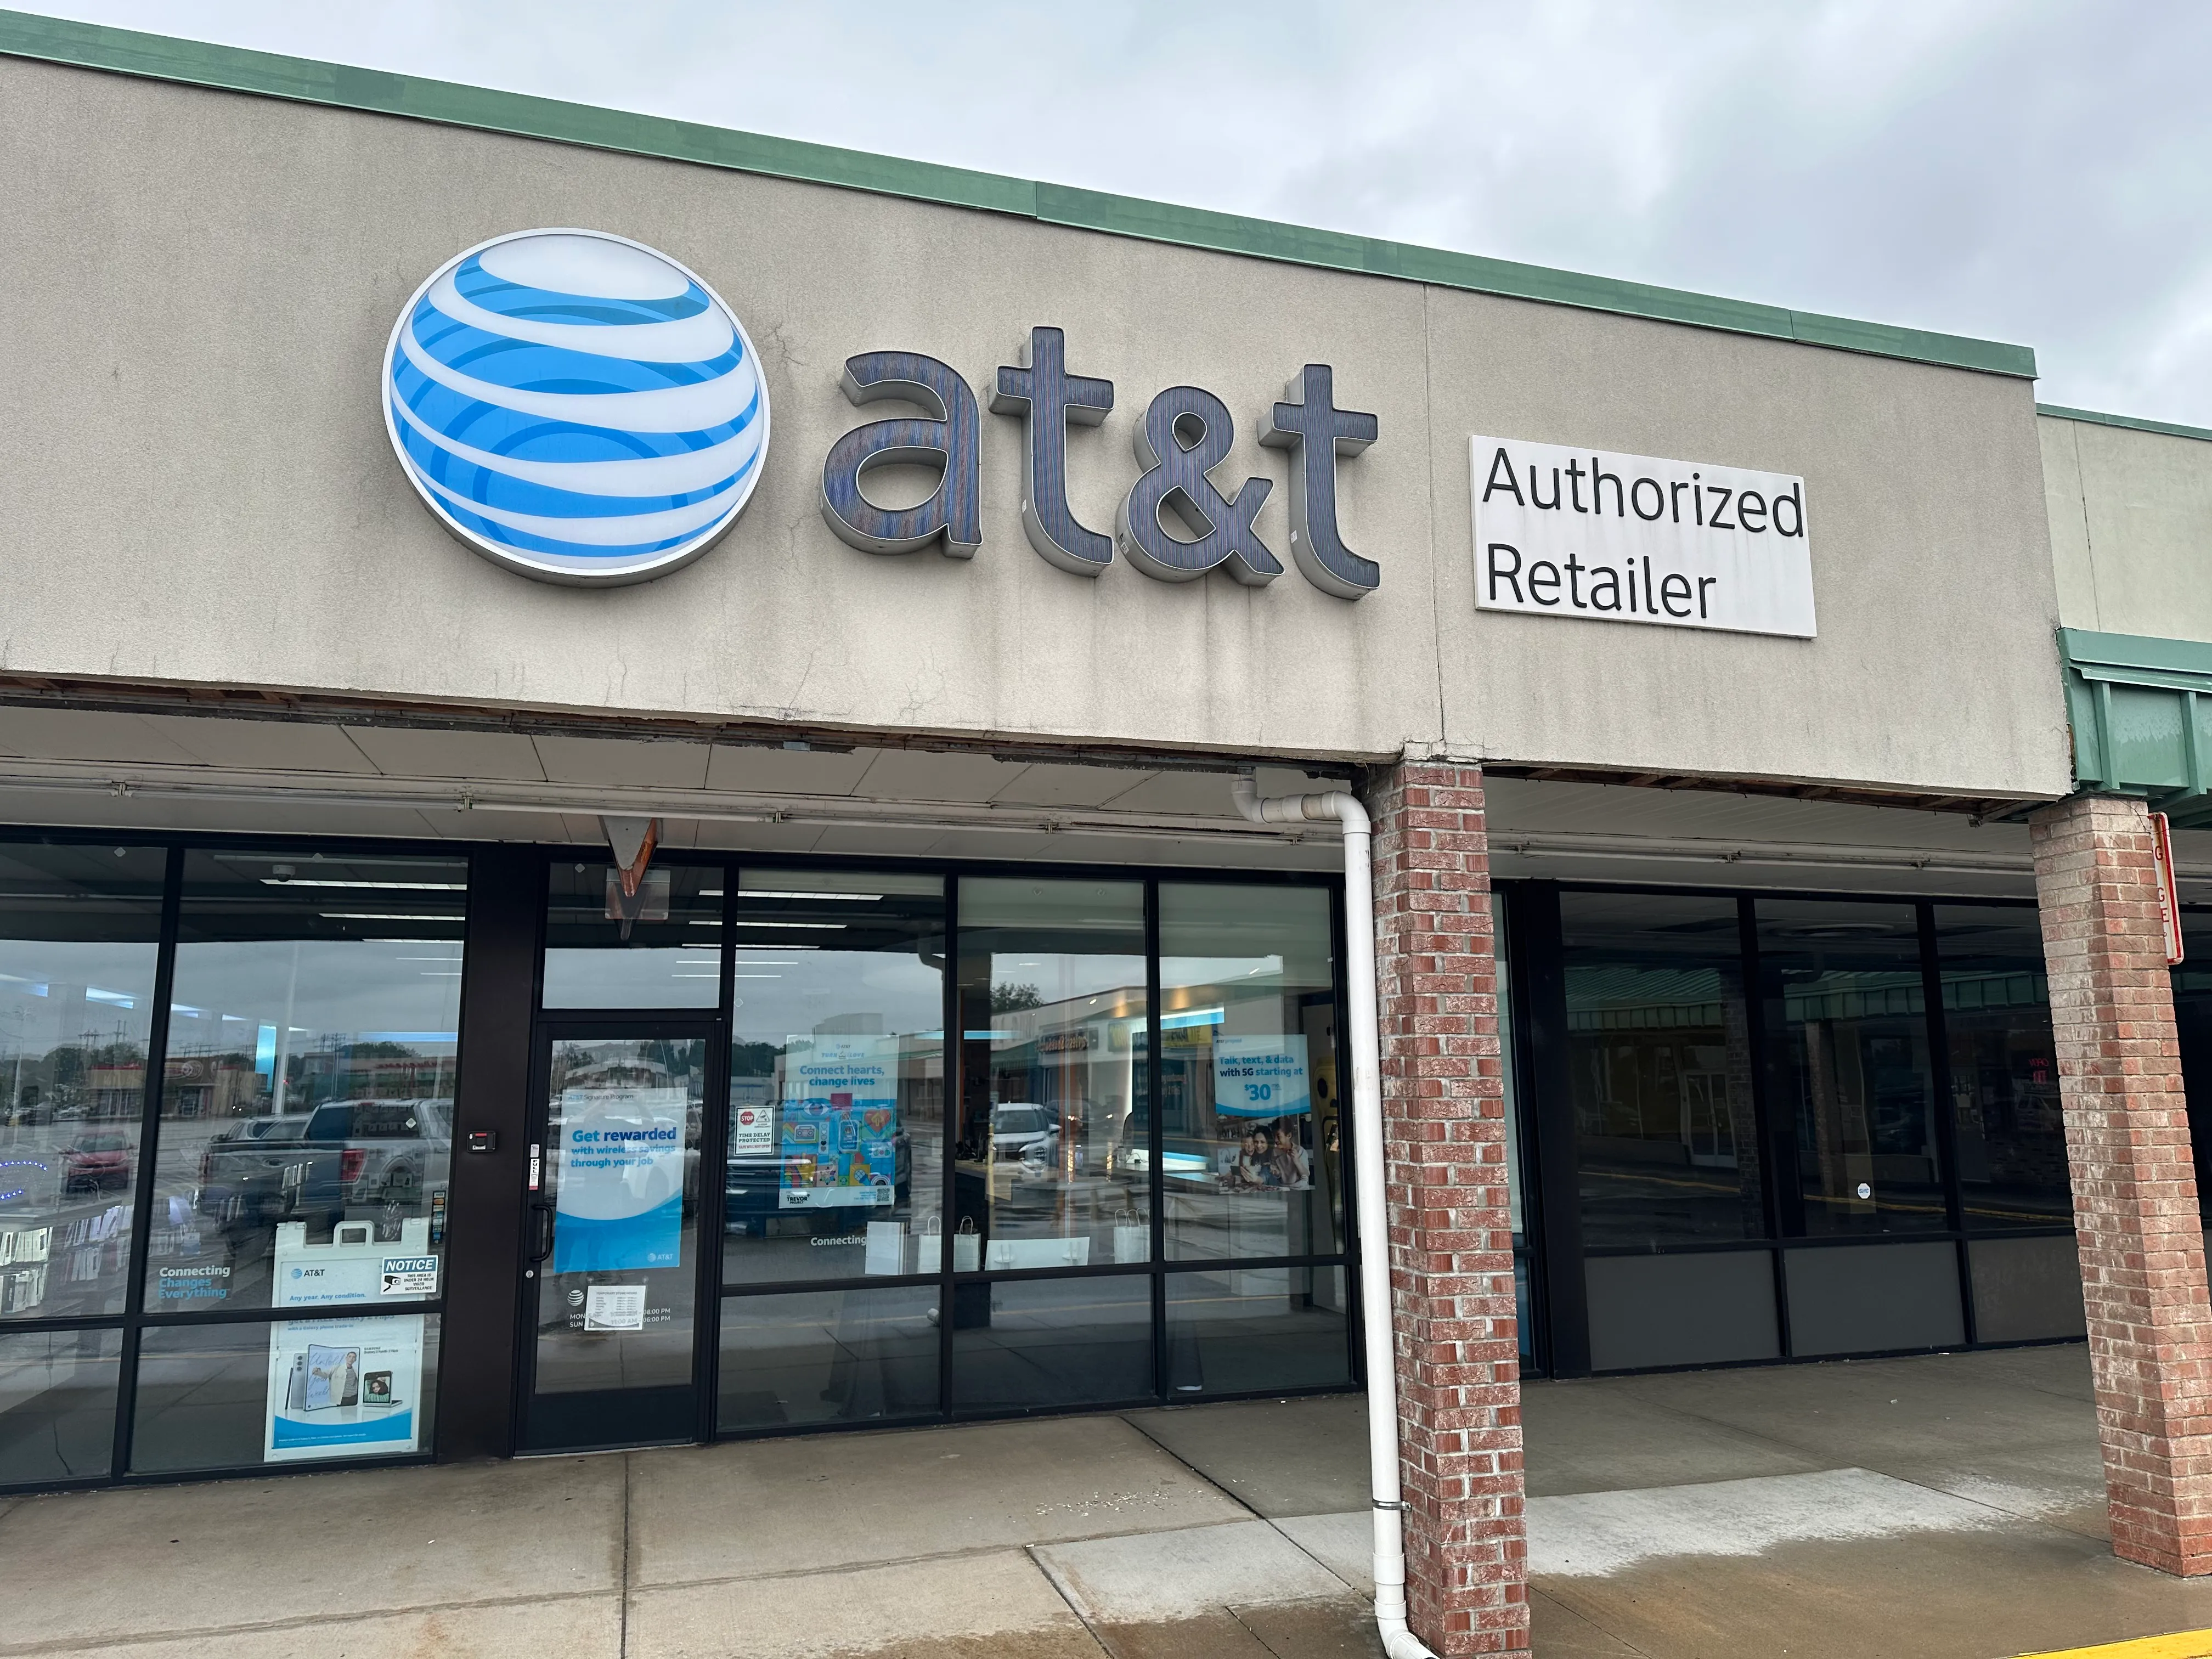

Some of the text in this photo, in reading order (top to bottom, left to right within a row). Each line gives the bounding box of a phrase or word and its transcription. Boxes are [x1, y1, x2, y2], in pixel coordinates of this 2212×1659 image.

[1482, 448, 1804, 538] Authorized
[1488, 543, 1717, 619] Retailer
[1219, 1054, 1294, 1065] Talk, text, & data
[800, 1065, 885, 1076] Connect hearts,
[1220, 1068, 1240, 1077] with
[1242, 1068, 1254, 1076] 5G
[1256, 1066, 1291, 1077] starting
[809, 1076, 875, 1088] change lives
[1244, 1084, 1271, 1101] $30
[572, 1127, 677, 1142] Get rewarded
[571, 1144, 676, 1155] with wireless savings
[571, 1156, 653, 1169] through your job
[810, 1235, 867, 1246] Connecting
[159, 1265, 230, 1278] Connecting
[386, 1259, 435, 1272] NOTICE
[303, 1269, 325, 1277] AT&T
[159, 1278, 212, 1290] Changes
[158, 1288, 227, 1301] Everything
